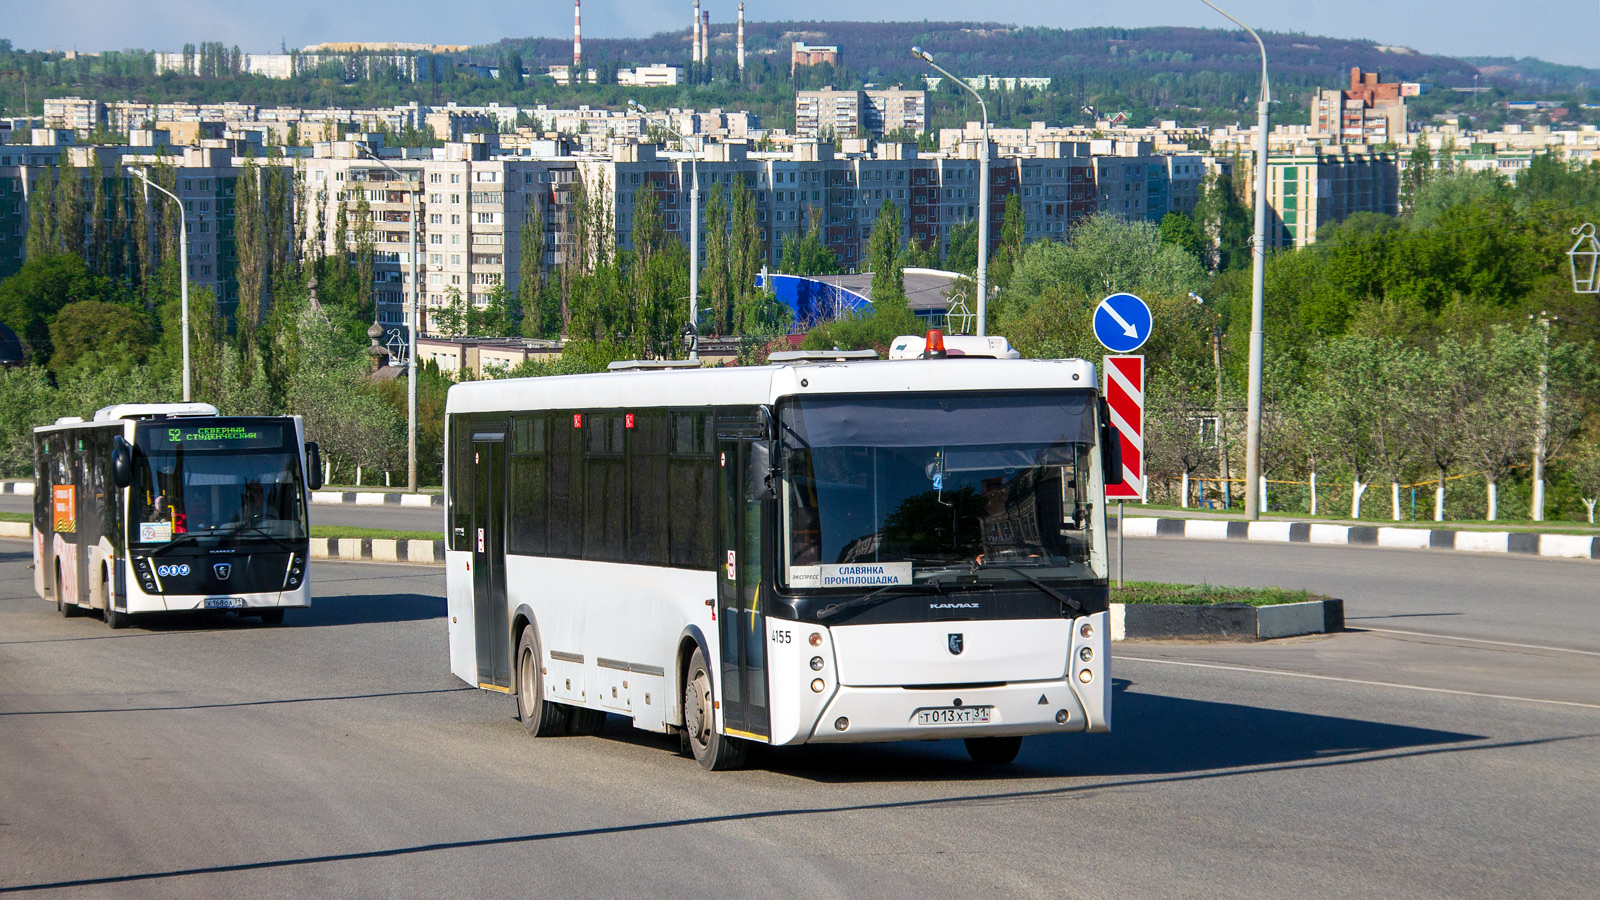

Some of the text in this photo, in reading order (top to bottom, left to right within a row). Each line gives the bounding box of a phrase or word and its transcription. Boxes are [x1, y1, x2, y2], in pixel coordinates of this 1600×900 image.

[168, 428, 181, 442] 52
[186, 433, 257, 441] СТУДЕНЧЕСКИЙ
[143, 529, 154, 538] 52
[838, 566, 884, 575] СЛАВЯНКА
[824, 575, 899, 585] ПРОМПЛОЩАДКА
[771, 629, 792, 644] 4155
[924, 708, 986, 722] Т013ХТ 31
